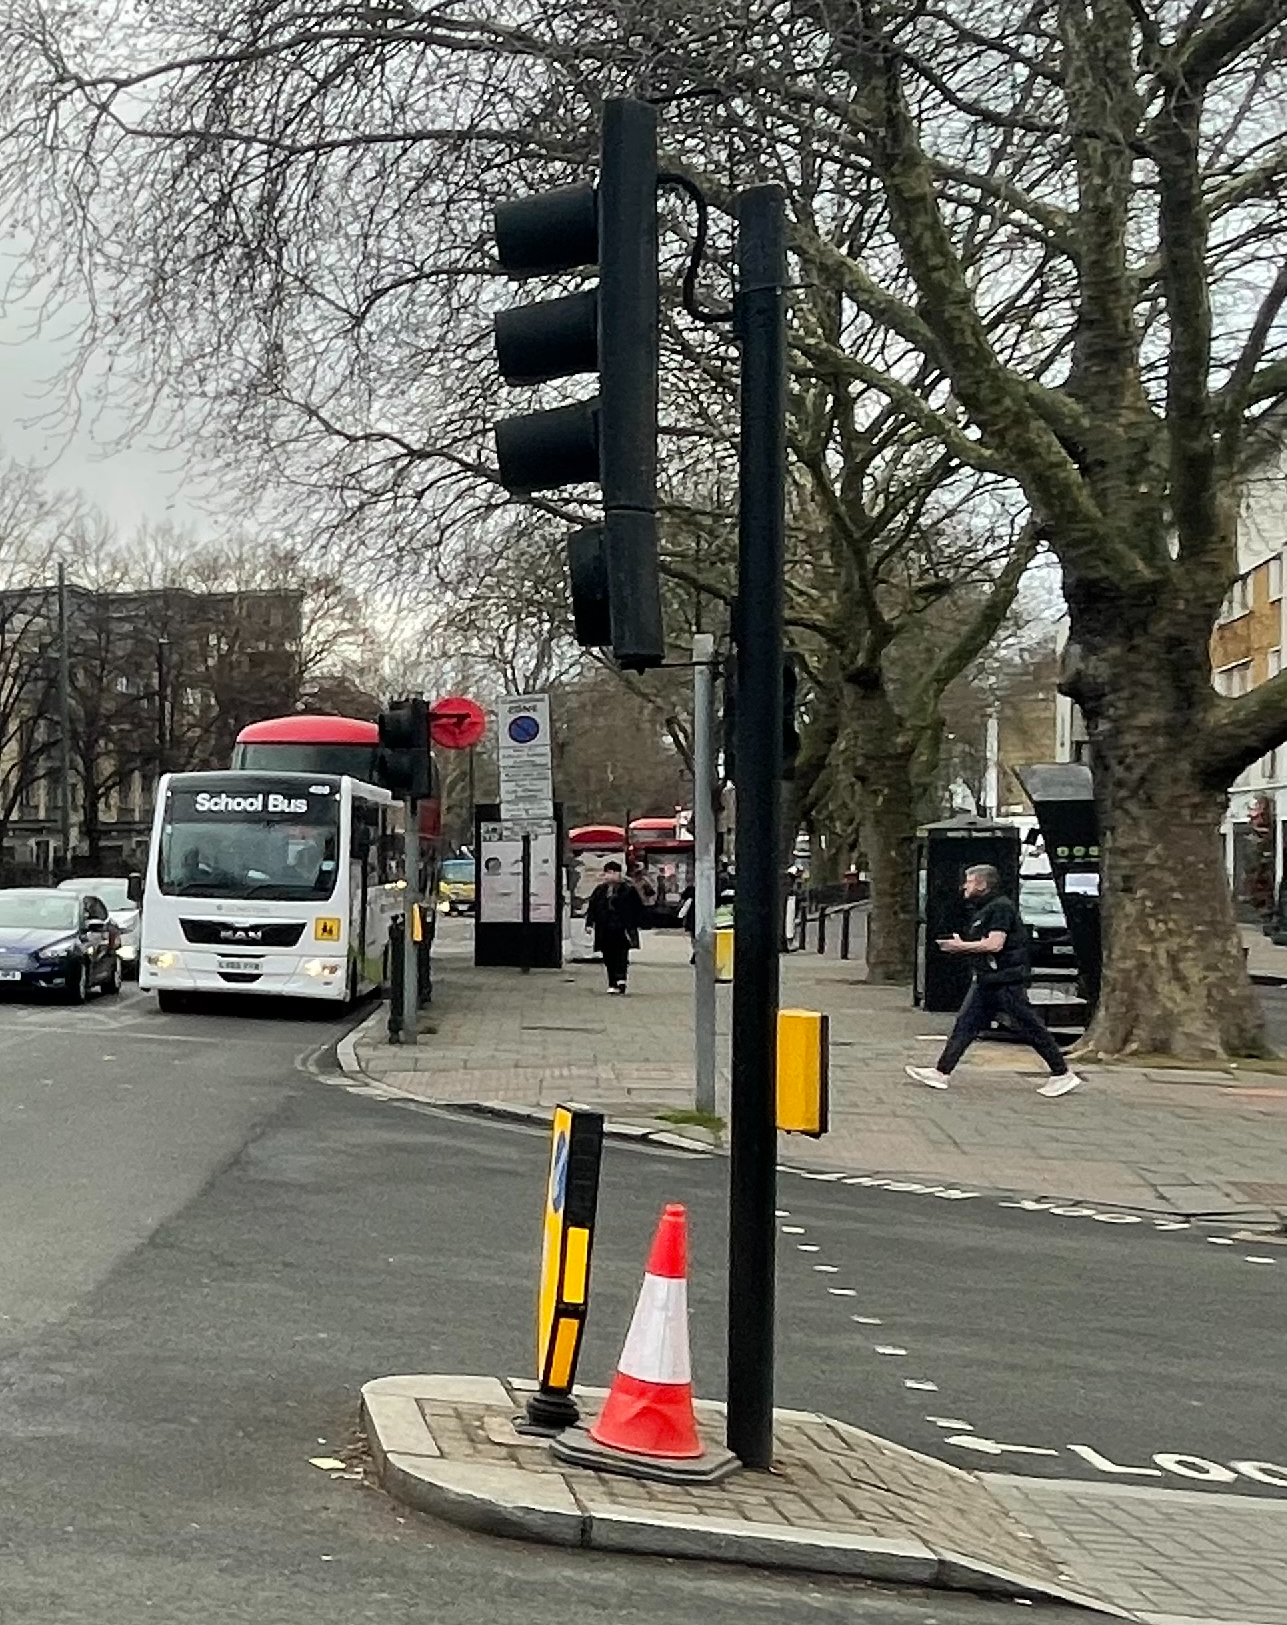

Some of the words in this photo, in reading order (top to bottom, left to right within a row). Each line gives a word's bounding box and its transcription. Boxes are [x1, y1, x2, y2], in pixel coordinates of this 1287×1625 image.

[195, 793, 263, 812] School
[268, 794, 308, 813] Bus
[1066, 1444, 1287, 1487] LOO
